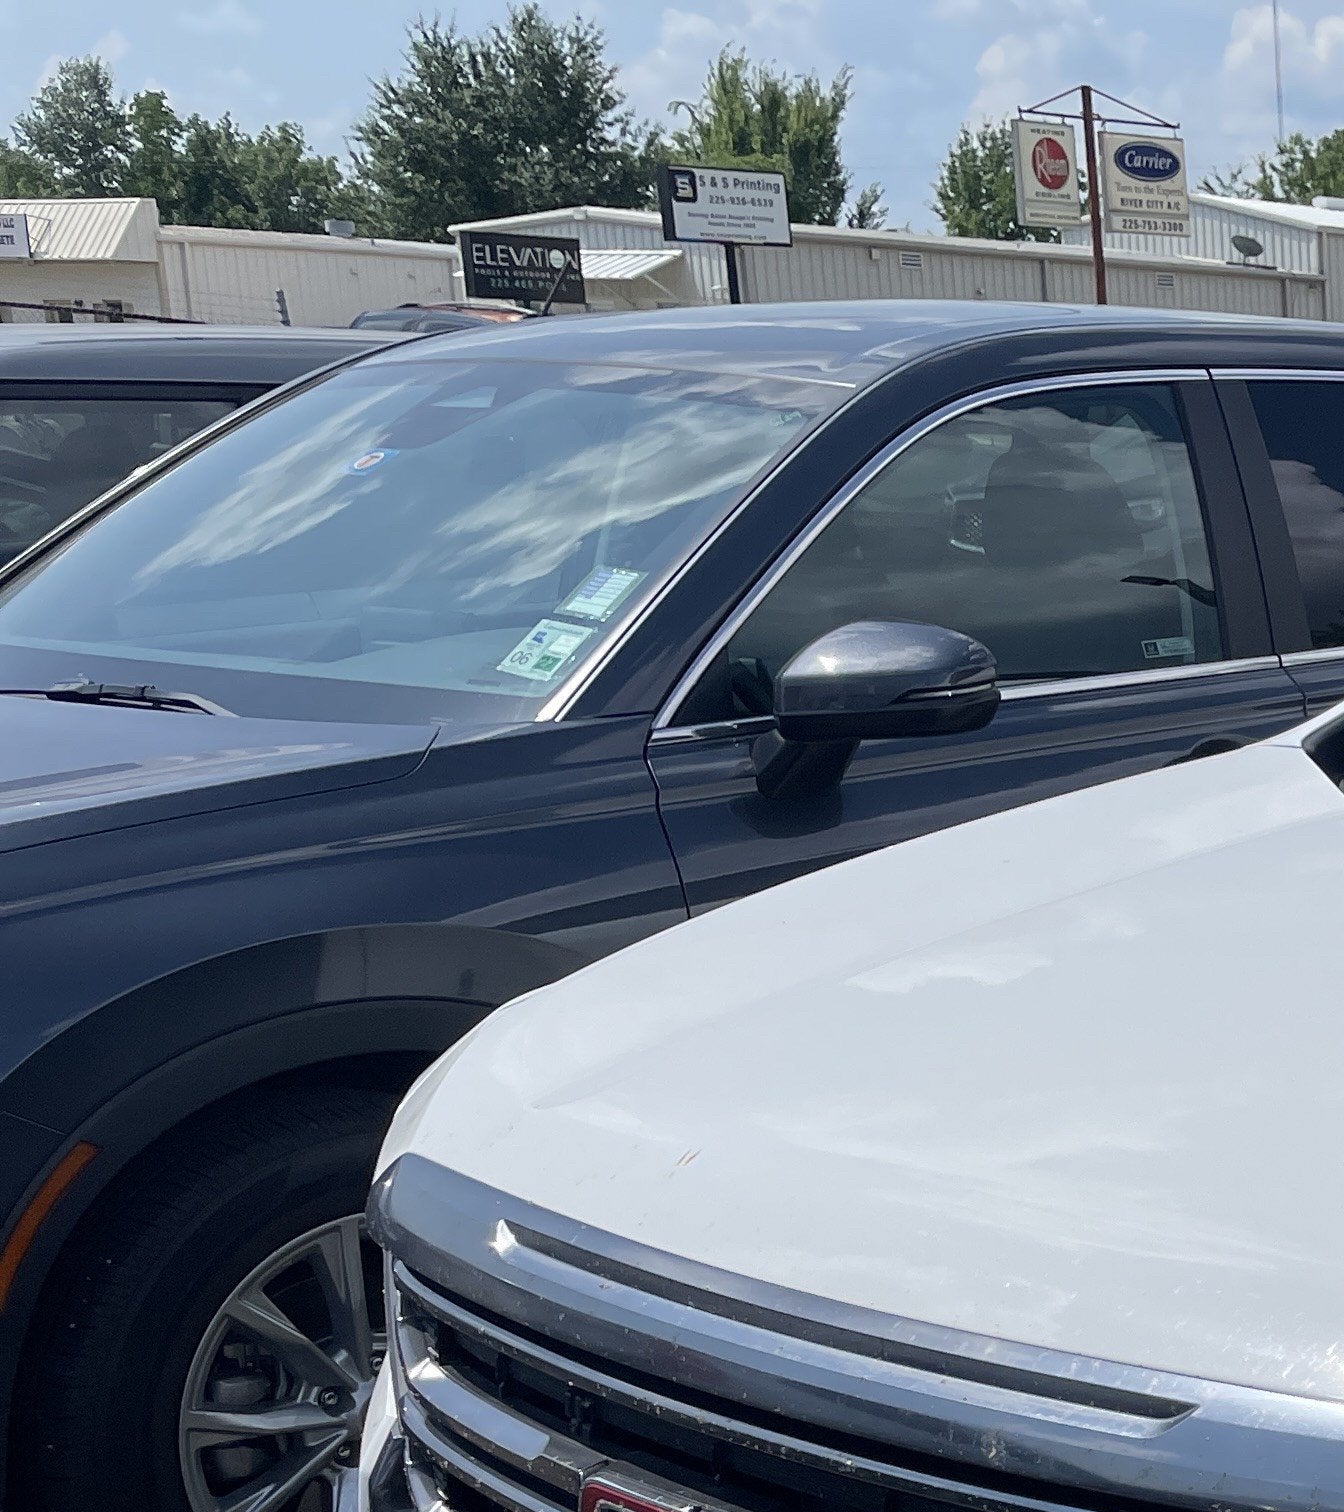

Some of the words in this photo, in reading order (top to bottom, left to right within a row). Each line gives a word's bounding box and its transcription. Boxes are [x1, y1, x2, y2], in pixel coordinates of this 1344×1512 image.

[1124, 150, 1173, 171] Carrier
[698, 175, 706, 188] S
[710, 176, 718, 189] &
[721, 177, 729, 190] S
[733, 178, 781, 194] Printing
[1147, 199, 1164, 209] CITY
[472, 243, 579, 271] ELEVATION
